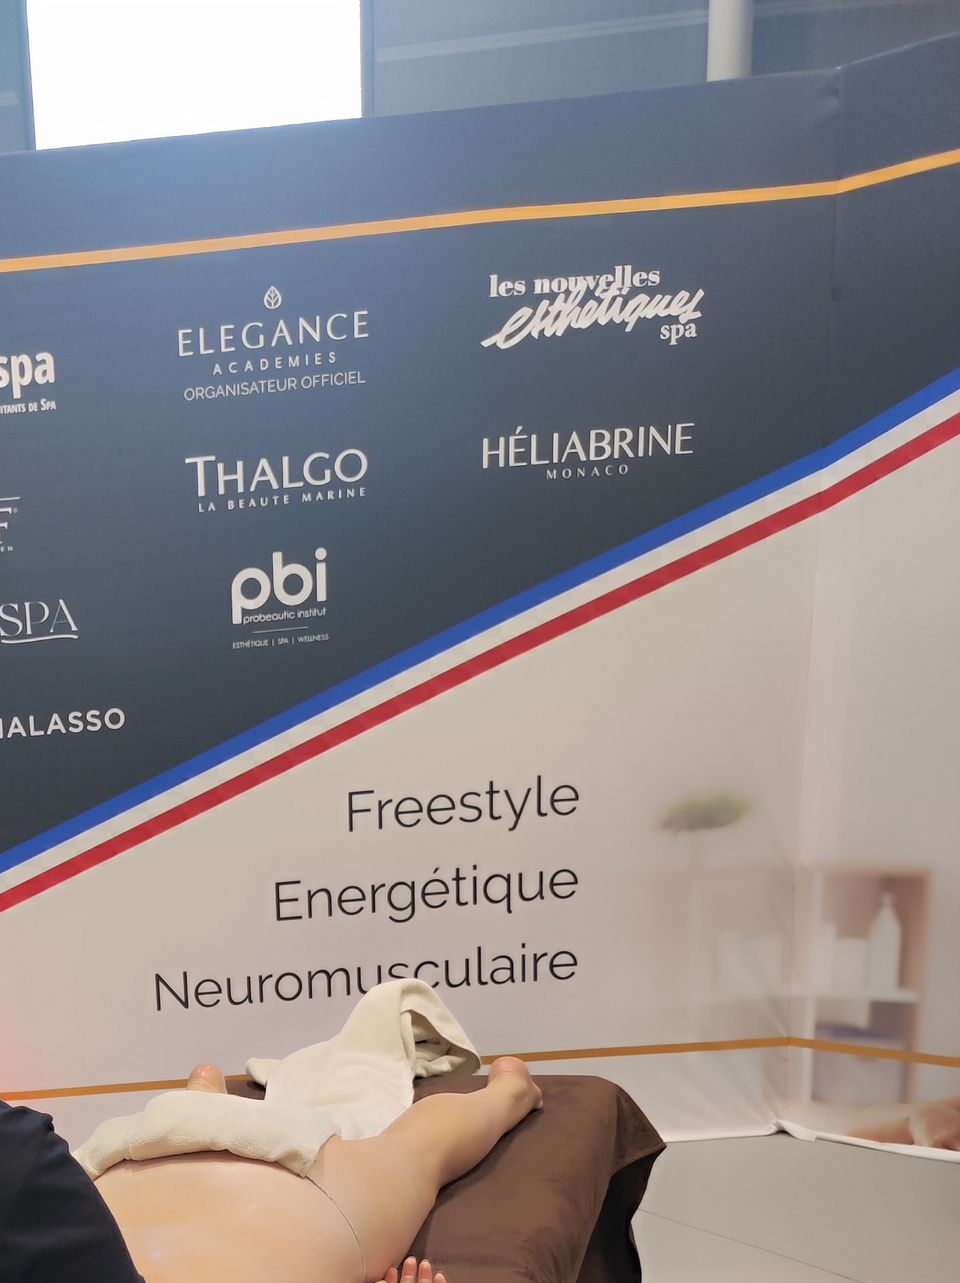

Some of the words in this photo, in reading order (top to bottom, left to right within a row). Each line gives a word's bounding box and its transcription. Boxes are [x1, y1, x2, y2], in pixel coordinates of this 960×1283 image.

[489, 273, 526, 298] les
[533, 264, 661, 295] nouvelles
[177, 310, 369, 357] ELEGANCE
[659, 321, 698, 345] spa
[213, 351, 337, 376] ACADEMIES
[183, 377, 297, 401] ORGANISATEUR
[301, 370, 366, 390] OFFICIEL
[482, 422, 695, 469] HÉLIABRINE
[184, 448, 369, 497] THALGO
[546, 463, 629, 480] MONACO
[198, 502, 216, 513] LA
[228, 494, 290, 511] BEAUTE
[302, 487, 367, 503] MARINE
[231, 547, 327, 625] pbi
[243, 610, 295, 625] probeautic
[297, 607, 327, 619] institut
[346, 774, 580, 833] Freestyle
[274, 864, 579, 923] Energétique
[154, 942, 579, 1011] Neuromusculaire
